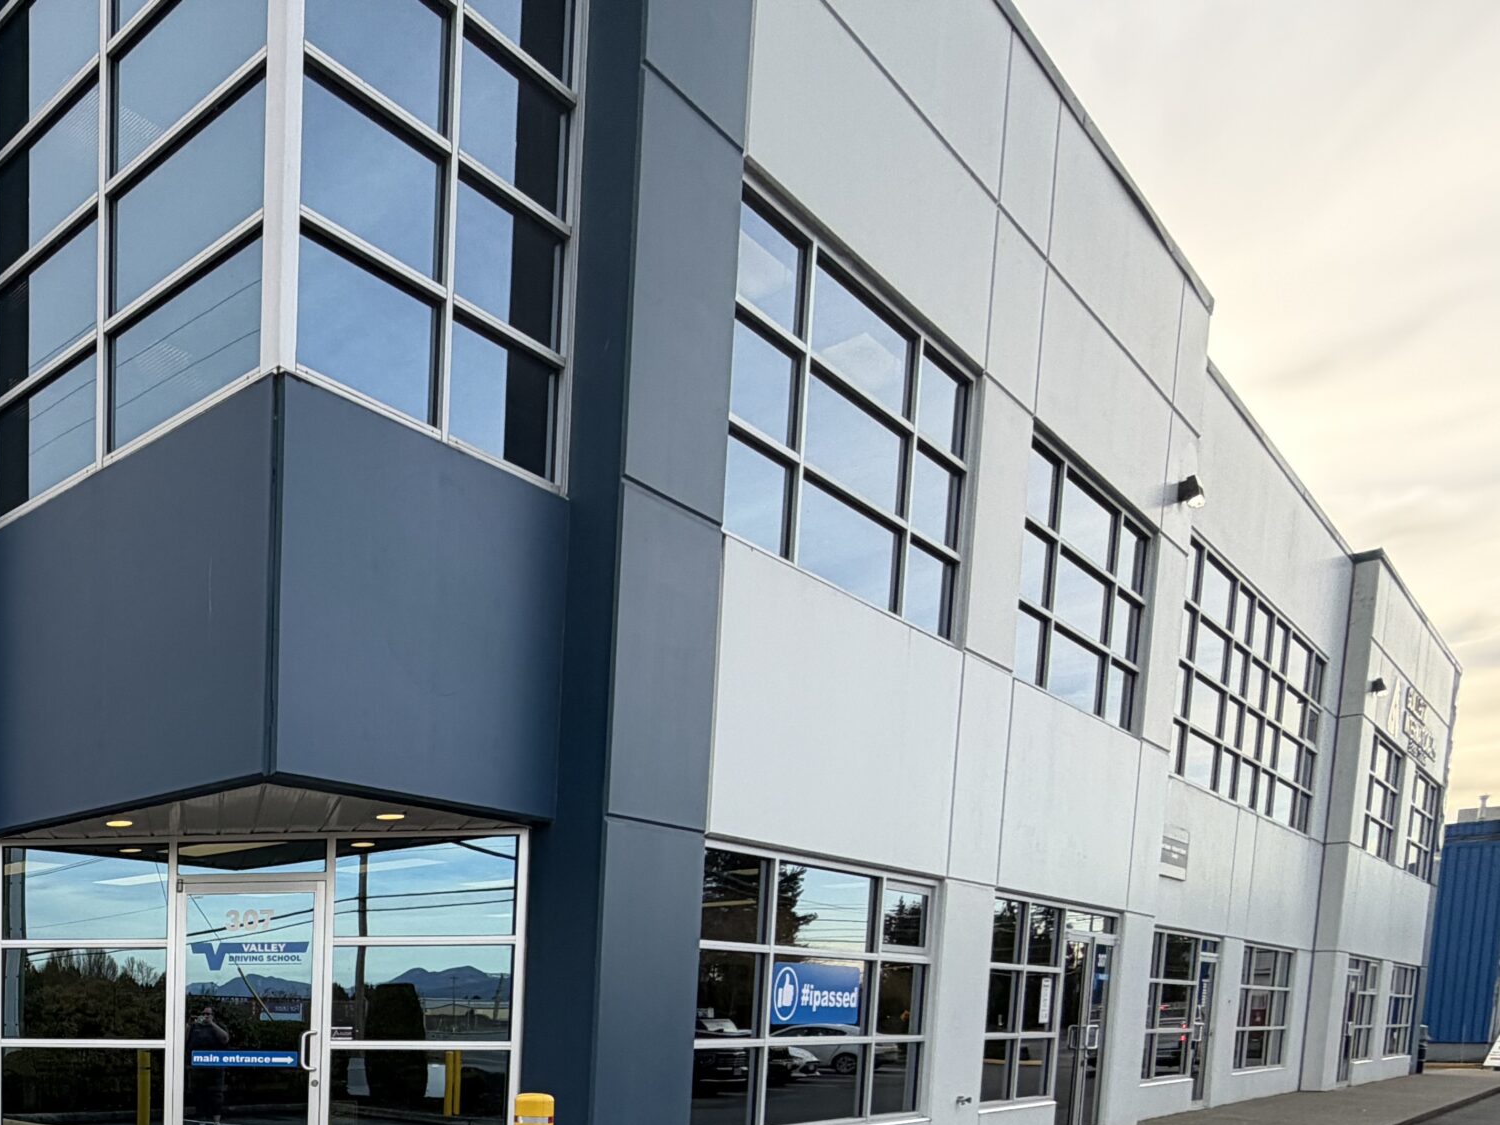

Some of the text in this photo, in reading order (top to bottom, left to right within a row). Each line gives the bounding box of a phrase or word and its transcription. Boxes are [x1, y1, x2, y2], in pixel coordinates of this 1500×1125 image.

[225, 909, 275, 932] 307
[242, 943, 286, 952] VALLEY
[228, 954, 302, 963] DRIVING SCHOOL
[800, 983, 859, 1012] #ipassed
[193, 1054, 271, 1064] main entrance
